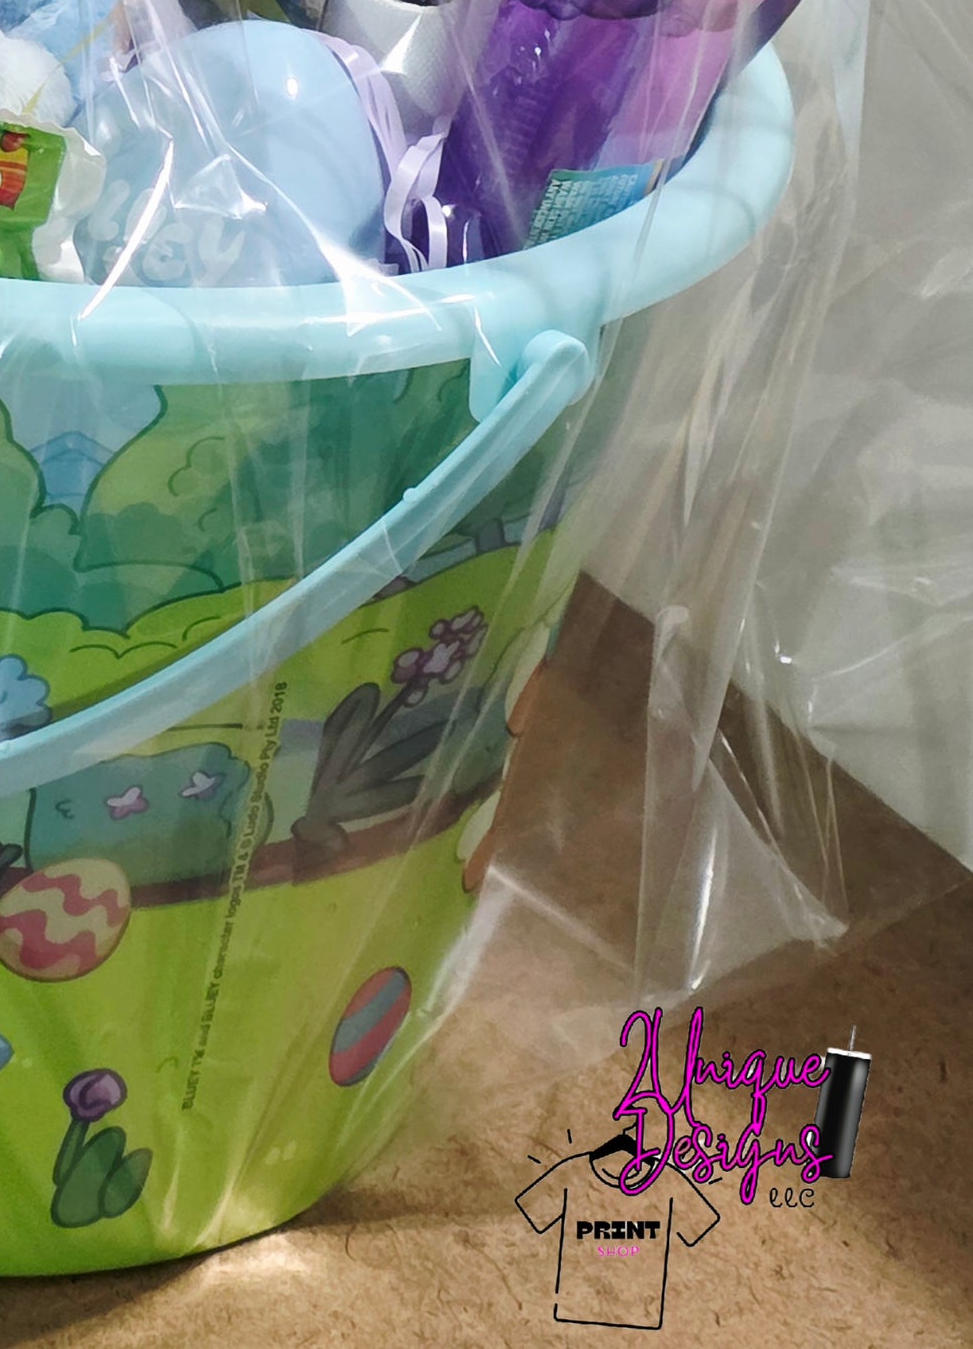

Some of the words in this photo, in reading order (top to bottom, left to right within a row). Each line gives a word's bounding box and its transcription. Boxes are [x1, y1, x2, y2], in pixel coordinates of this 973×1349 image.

[272, 680, 287, 714] 2018
[267, 714, 278, 738] Ltd
[262, 738, 275, 761] Pty
[252, 760, 268, 803] Studio
[245, 804, 258, 838] Ludo
[204, 981, 219, 1022] BLUEY
[184, 1069, 199, 1111] BLUEY
